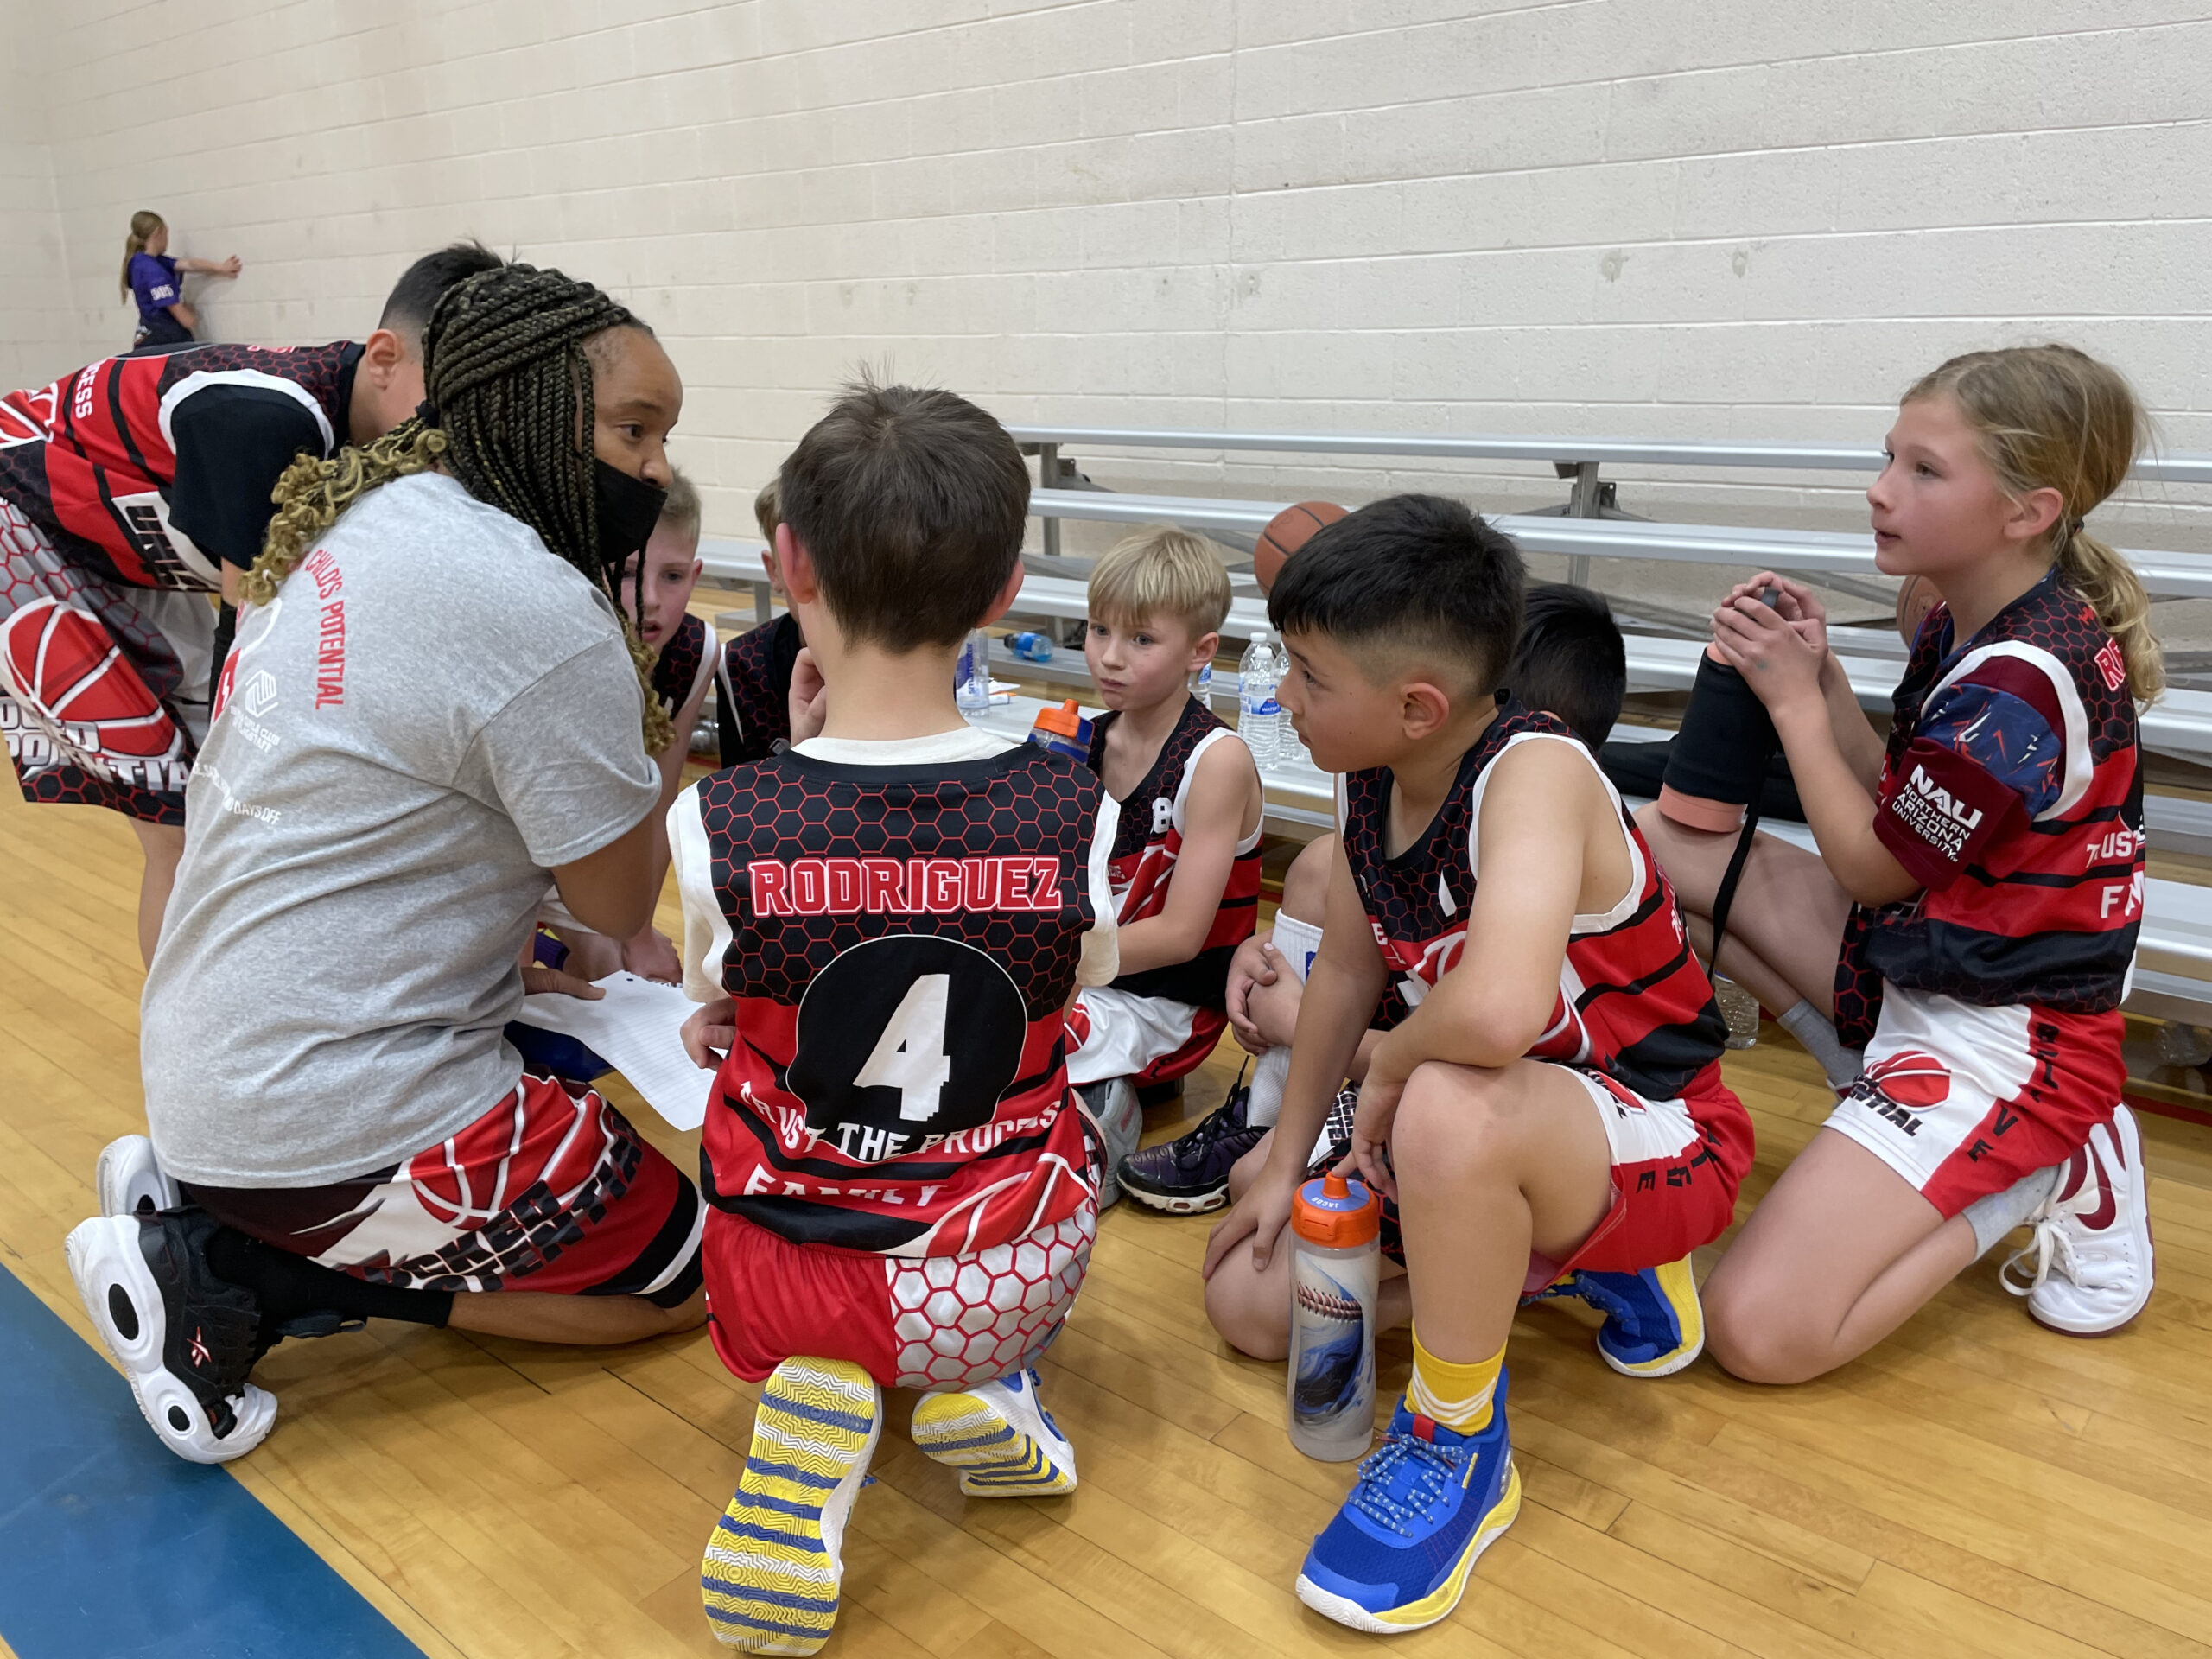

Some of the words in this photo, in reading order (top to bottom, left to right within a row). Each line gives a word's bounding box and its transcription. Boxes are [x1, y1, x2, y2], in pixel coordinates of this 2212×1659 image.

[305, 549, 343, 601] CHILD'S
[315, 600, 346, 710] POTENTIAL
[1897, 792, 1963, 852] ARIZONA
[1904, 783, 1971, 840] NORTHERN
[1910, 763, 1984, 830] NAU
[1891, 800, 1957, 859] UNIVERSITY
[747, 855, 1063, 917] RODRIGUEZ
[852, 973, 950, 1122] 4
[740, 1080, 827, 1154] TRUST
[837, 1122, 911, 1161] THE
[1311, 1196, 1339, 1209] JACOB
